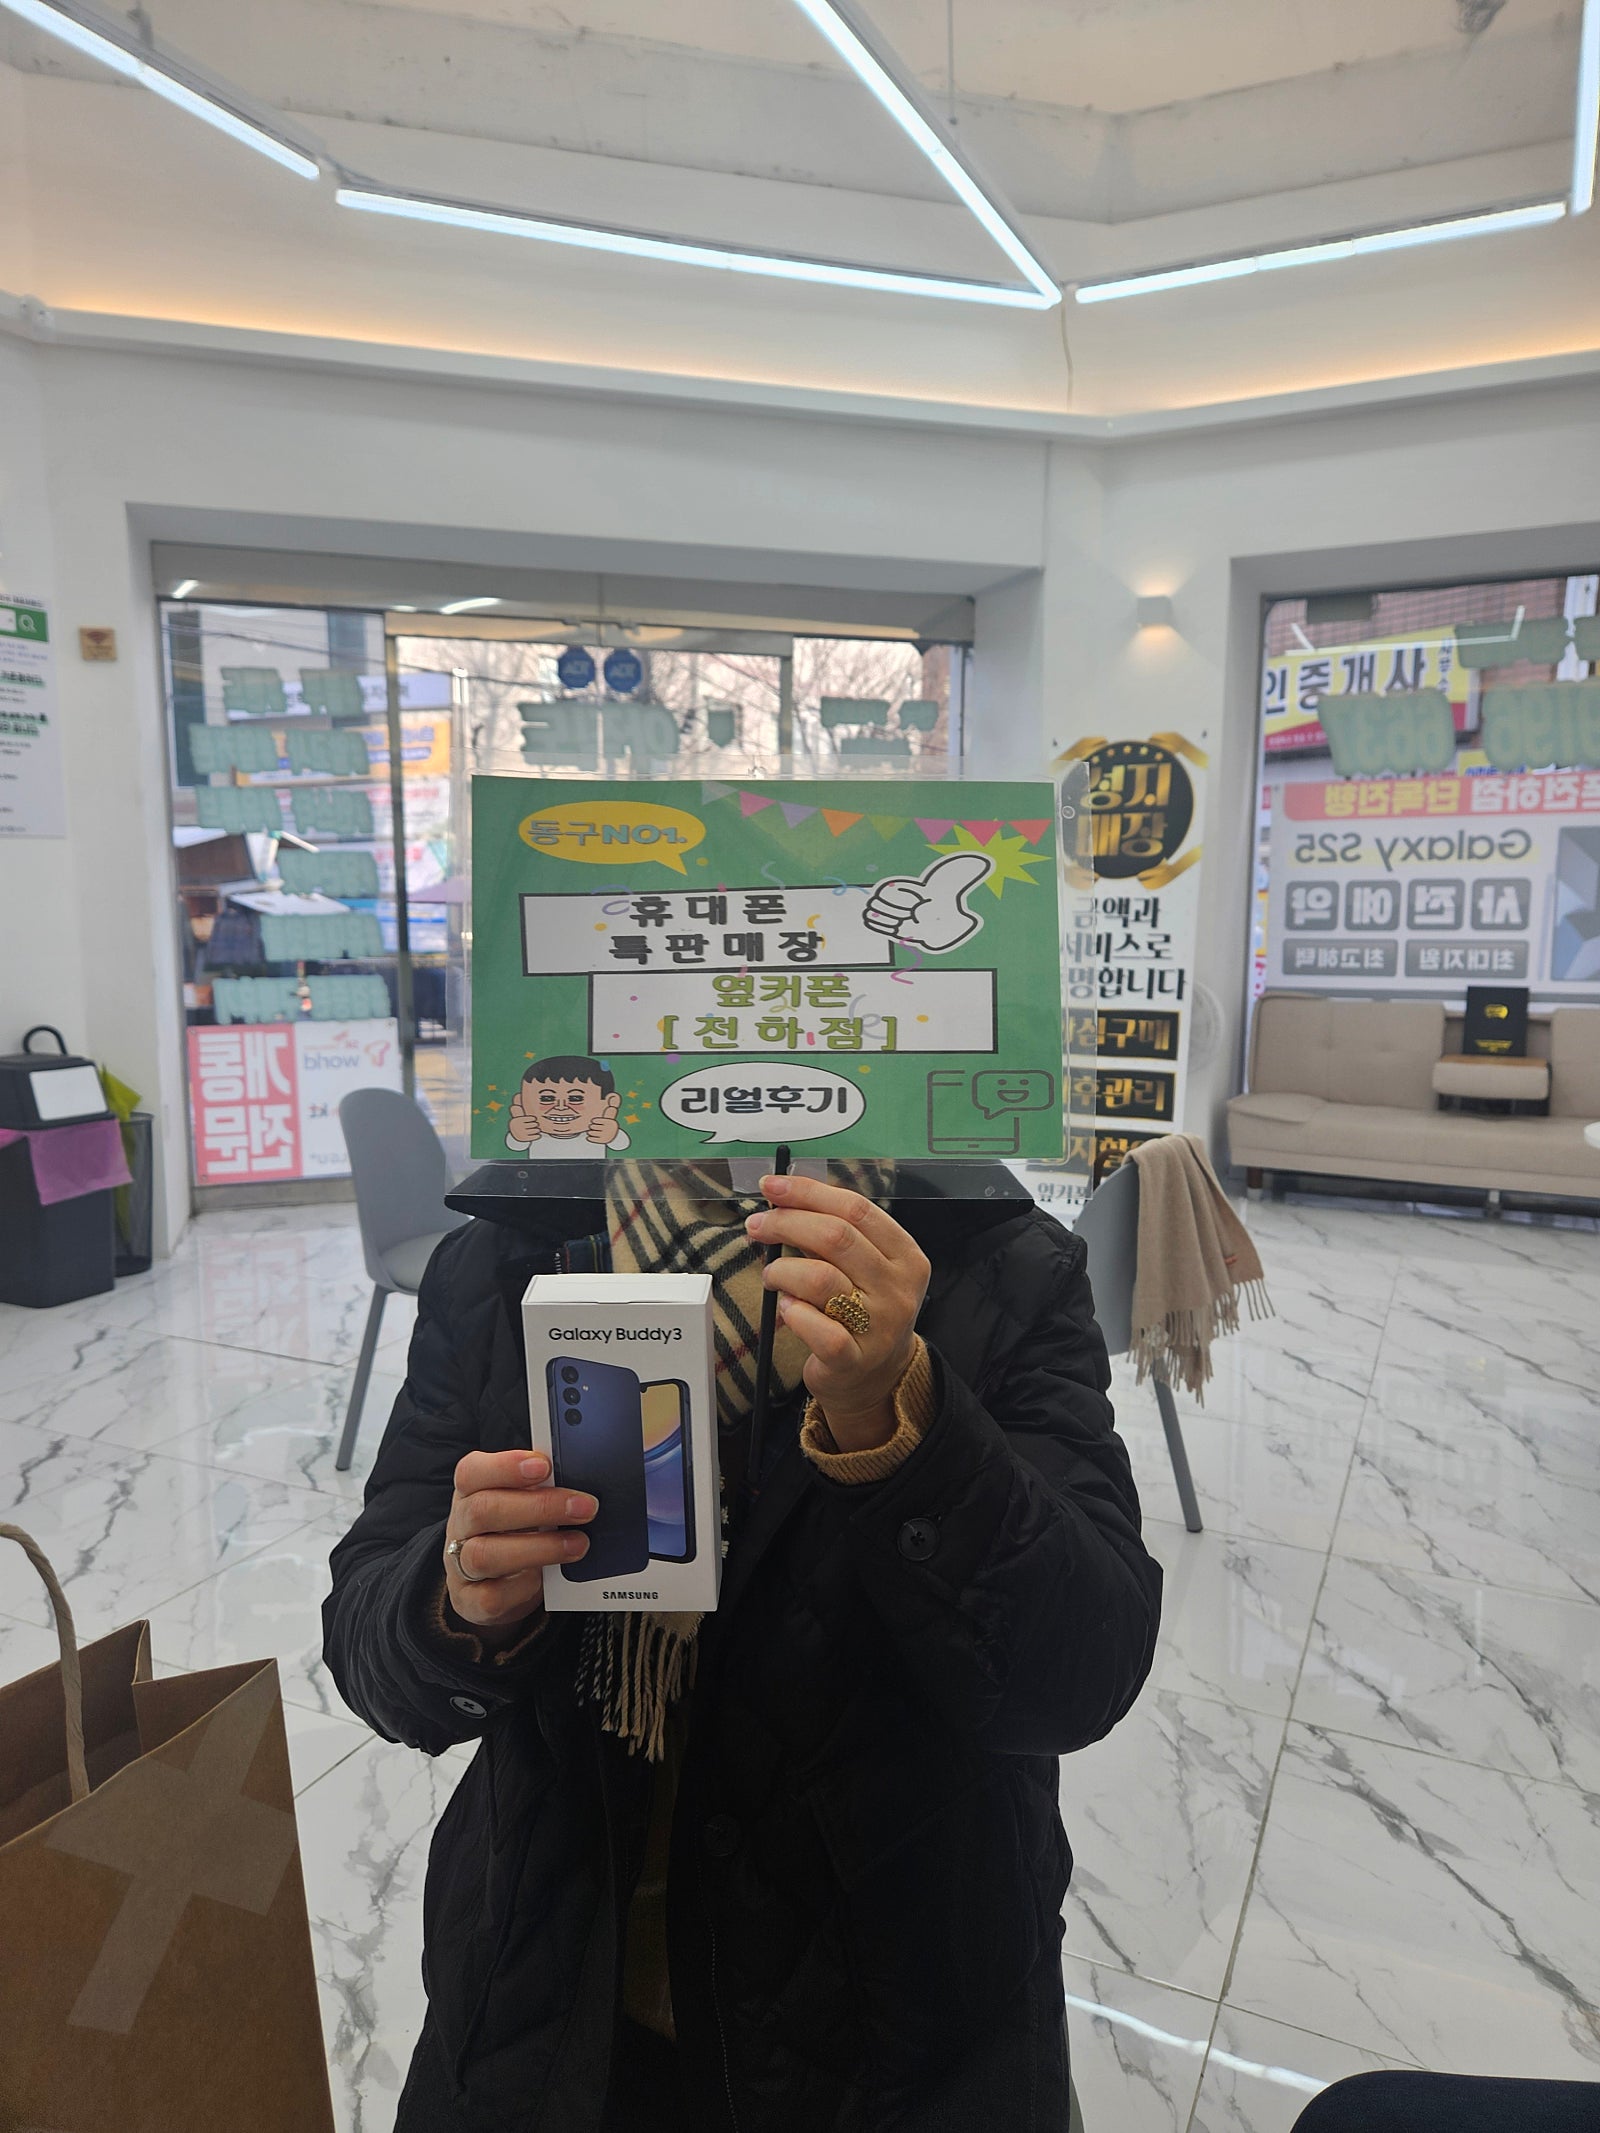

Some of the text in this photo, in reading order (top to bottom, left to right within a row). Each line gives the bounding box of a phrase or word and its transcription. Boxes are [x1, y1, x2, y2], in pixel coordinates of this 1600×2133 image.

[1075, 812, 1169, 856] 매장
[1072, 897, 1161, 929] 금액과
[712, 974, 852, 1008] 옆커폰
[1064, 1016, 1171, 1051] 심구매
[681, 1085, 848, 1115] 리얼후기
[1063, 1075, 1166, 1112] 후관리
[548, 1327, 683, 1345] Galaxy Buddy3
[602, 1590, 659, 1601] SAMSUNG
